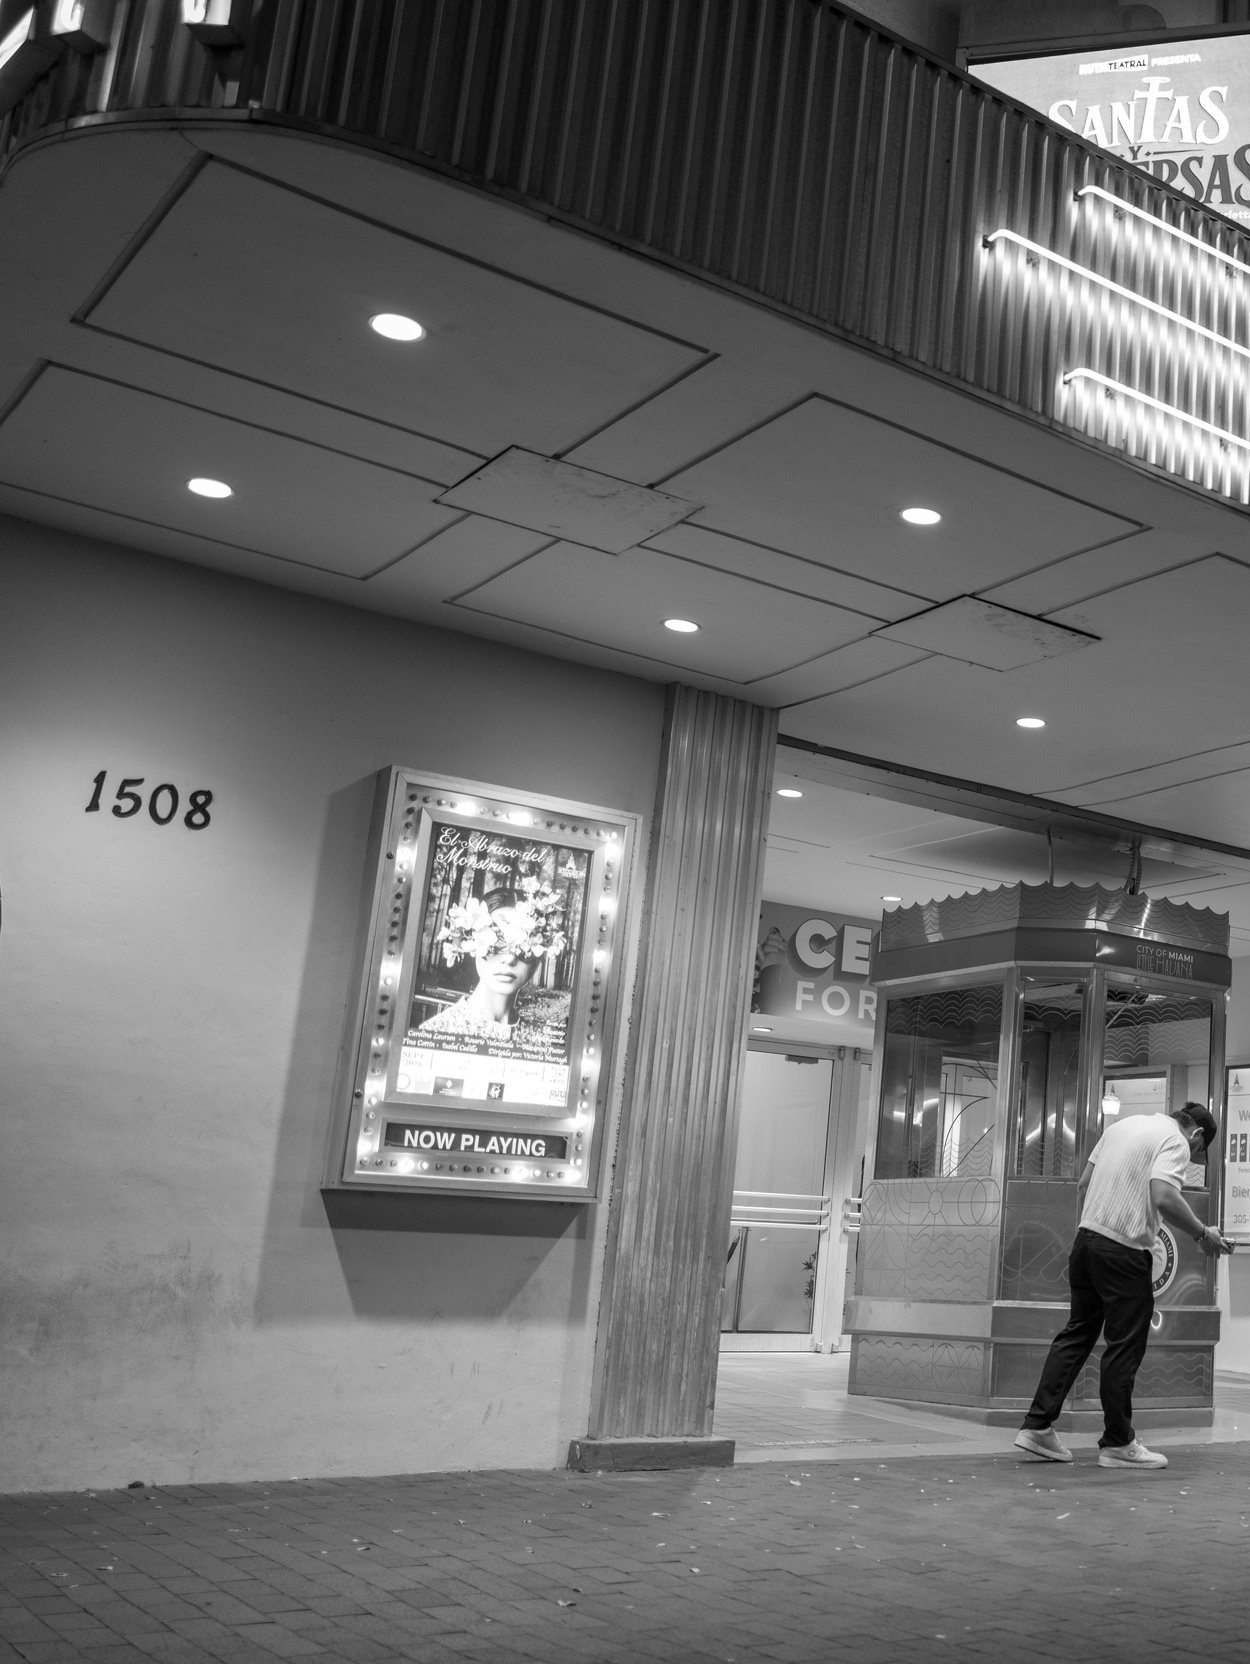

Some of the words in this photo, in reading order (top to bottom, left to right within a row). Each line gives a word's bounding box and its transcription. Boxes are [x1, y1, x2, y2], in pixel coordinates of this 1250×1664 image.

[1108, 58, 1147, 71] TEATRAL
[1151, 53, 1202, 67] PRESENTA
[1048, 76, 1230, 149] SANTAS
[1129, 145, 1143, 161] Y
[84, 769, 214, 831] 1508
[439, 826, 460, 847] El
[461, 835, 520, 858] Abrazo
[522, 847, 549, 863] del
[436, 847, 513, 874] Monstruo
[1136, 944, 1155, 955] CITY
[1155, 948, 1167, 958] OF
[1168, 951, 1194, 963] MIAMI
[1156, 957, 1193, 979] HAVANA
[795, 980, 877, 1020] FOR
[403, 1129, 456, 1150] NOW
[460, 1133, 546, 1157] PLAYING
